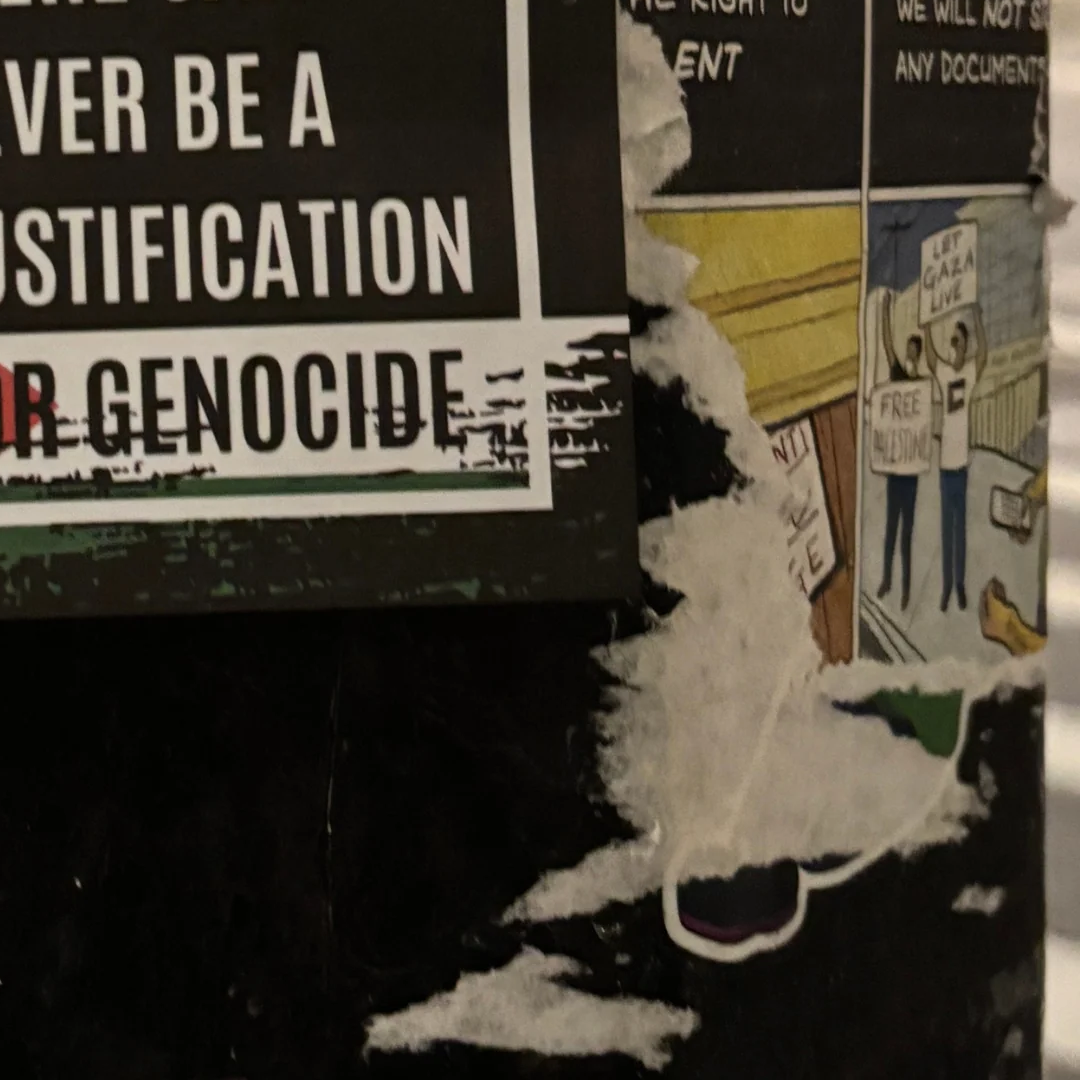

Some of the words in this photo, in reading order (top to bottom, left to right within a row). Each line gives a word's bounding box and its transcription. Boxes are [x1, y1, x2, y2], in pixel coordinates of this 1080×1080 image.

[895, 49, 935, 84] ANY
[173, 52, 264, 152] BE
[288, 50, 336, 149] A
[932, 228, 964, 260] LET
[922, 250, 974, 291] GAZA
[930, 286, 962, 314] LIVE
[86, 350, 464, 457] GENOCIDE
[879, 390, 921, 420] FREE
